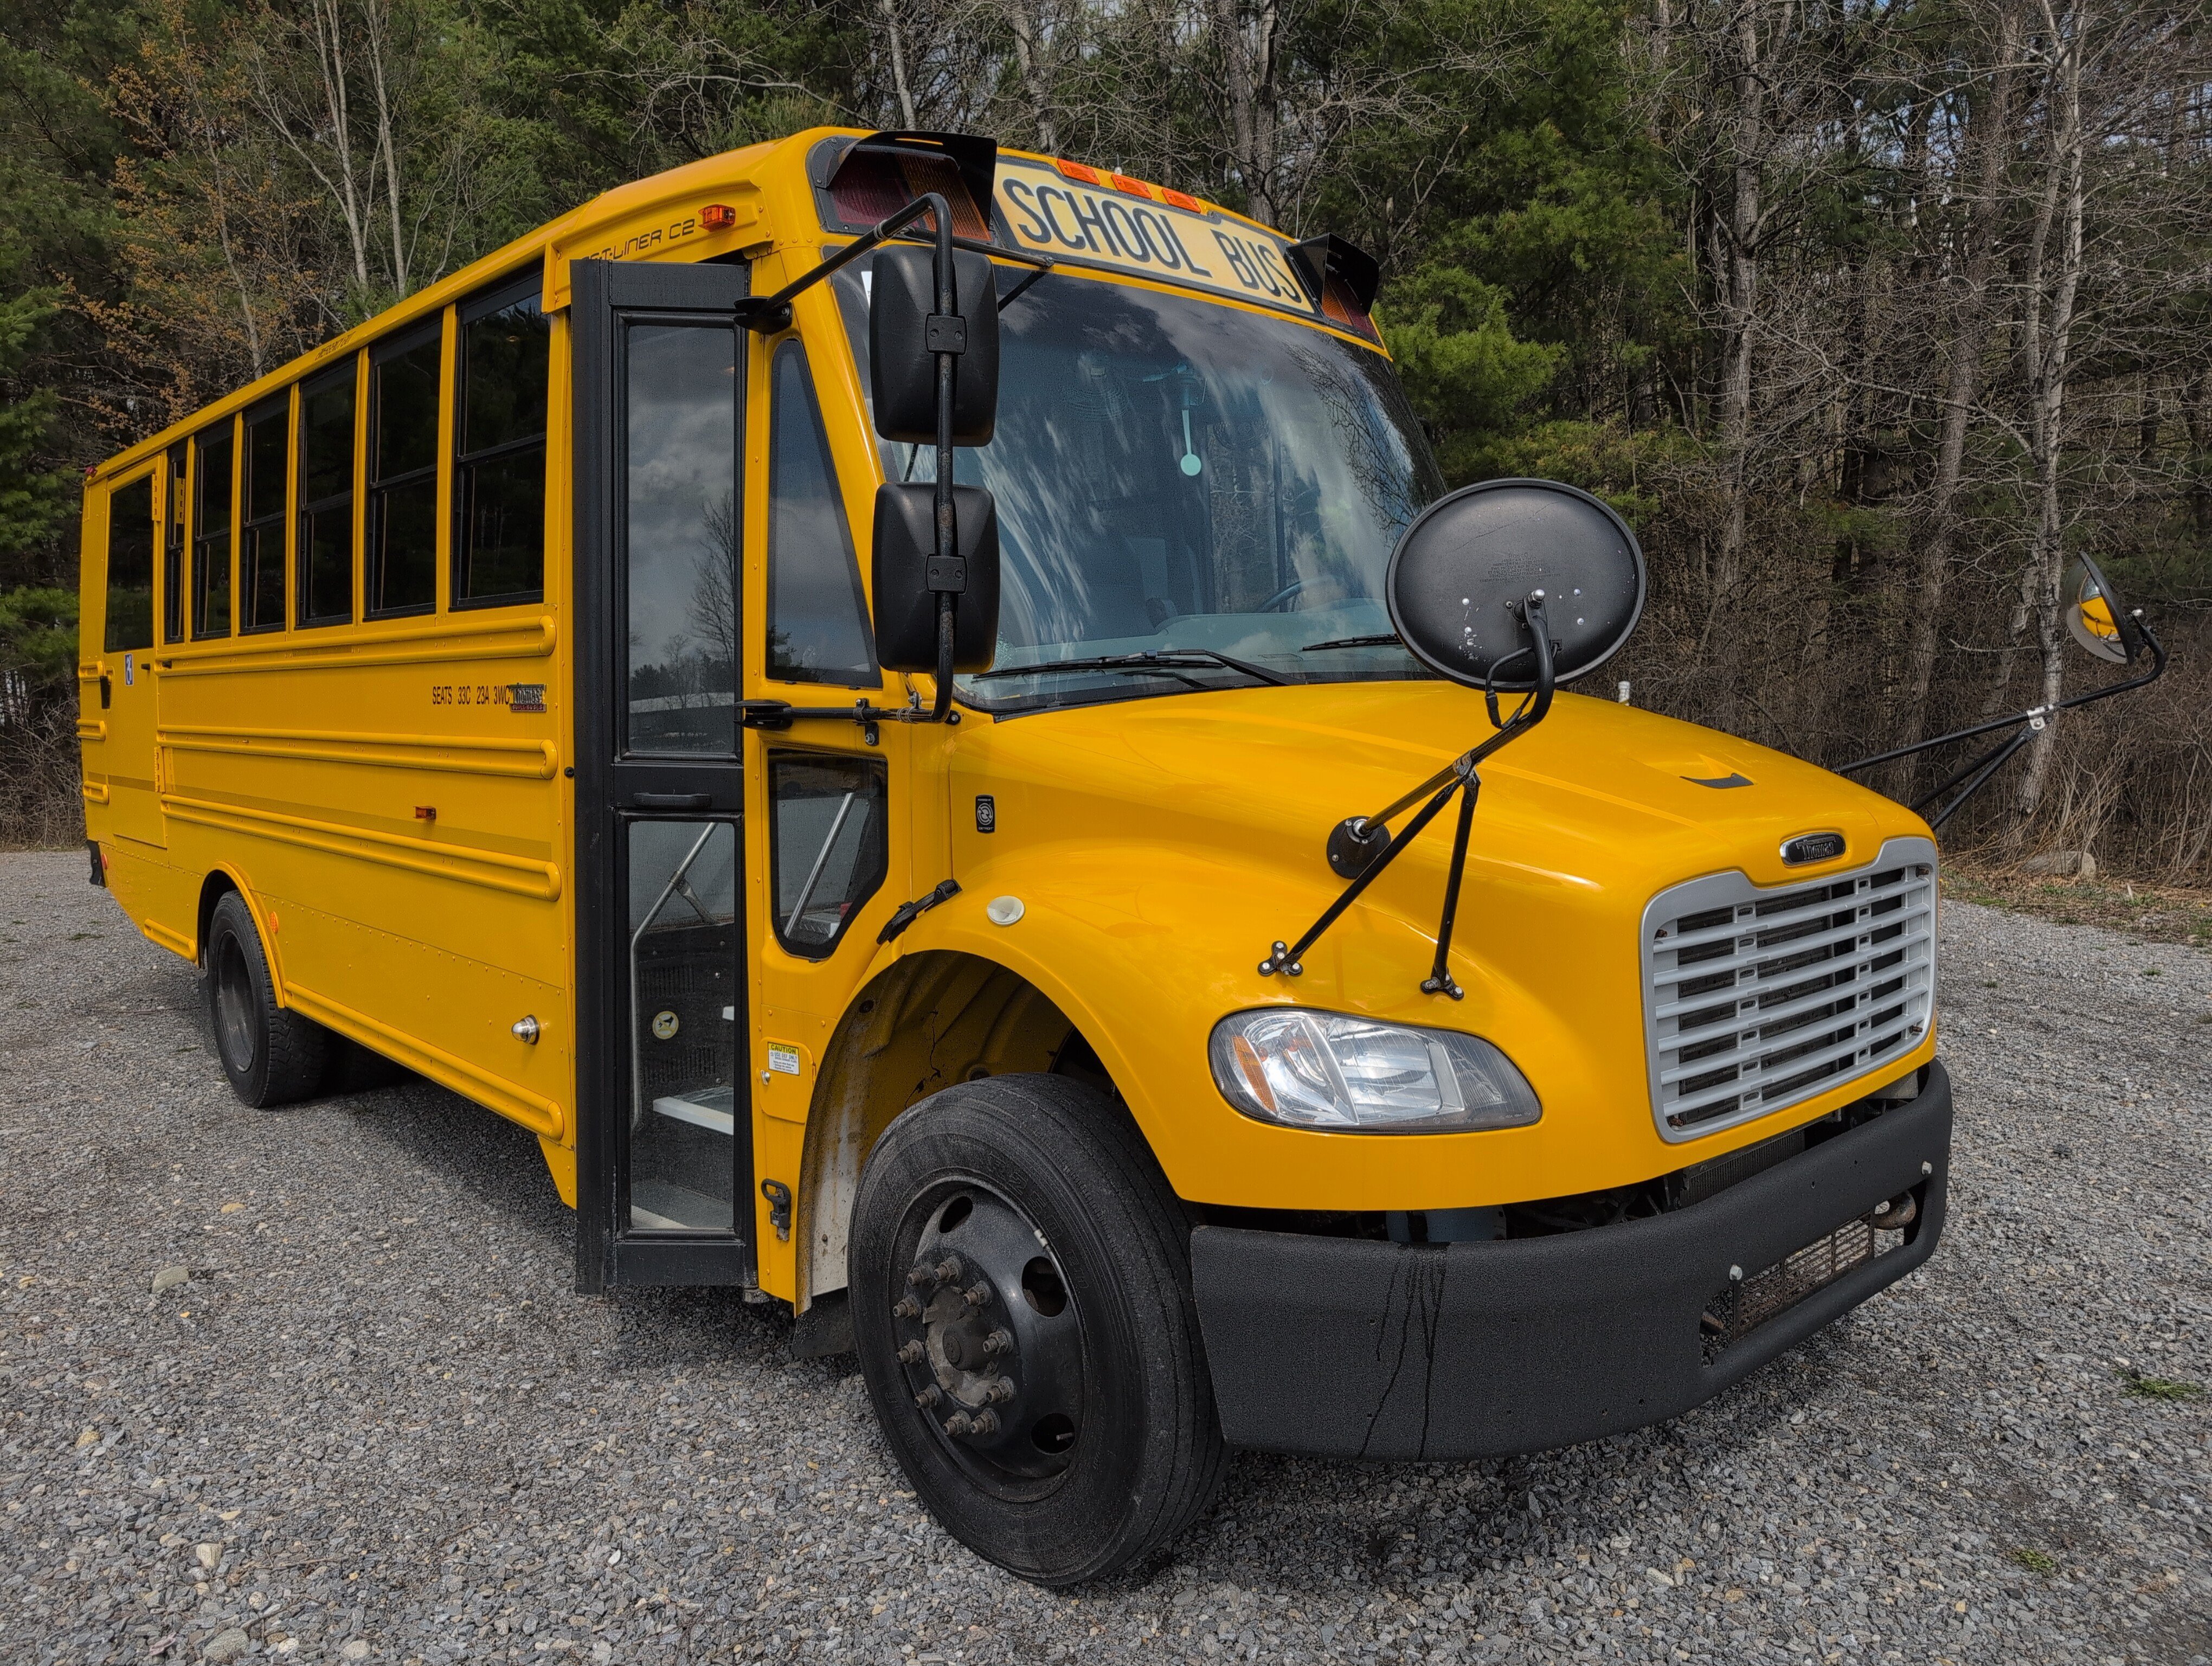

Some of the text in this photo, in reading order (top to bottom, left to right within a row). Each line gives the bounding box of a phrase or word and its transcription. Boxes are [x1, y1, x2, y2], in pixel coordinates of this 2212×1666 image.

[668, 218, 696, 240] C2
[1003, 178, 1302, 304] SCHOOL BUS
[432, 684, 511, 705] SEATS 33C 23A 3WC
[509, 682, 547, 704] Thomas
[1795, 836, 1837, 860] Thomas
[770, 1044, 796, 1054] CAUTION
